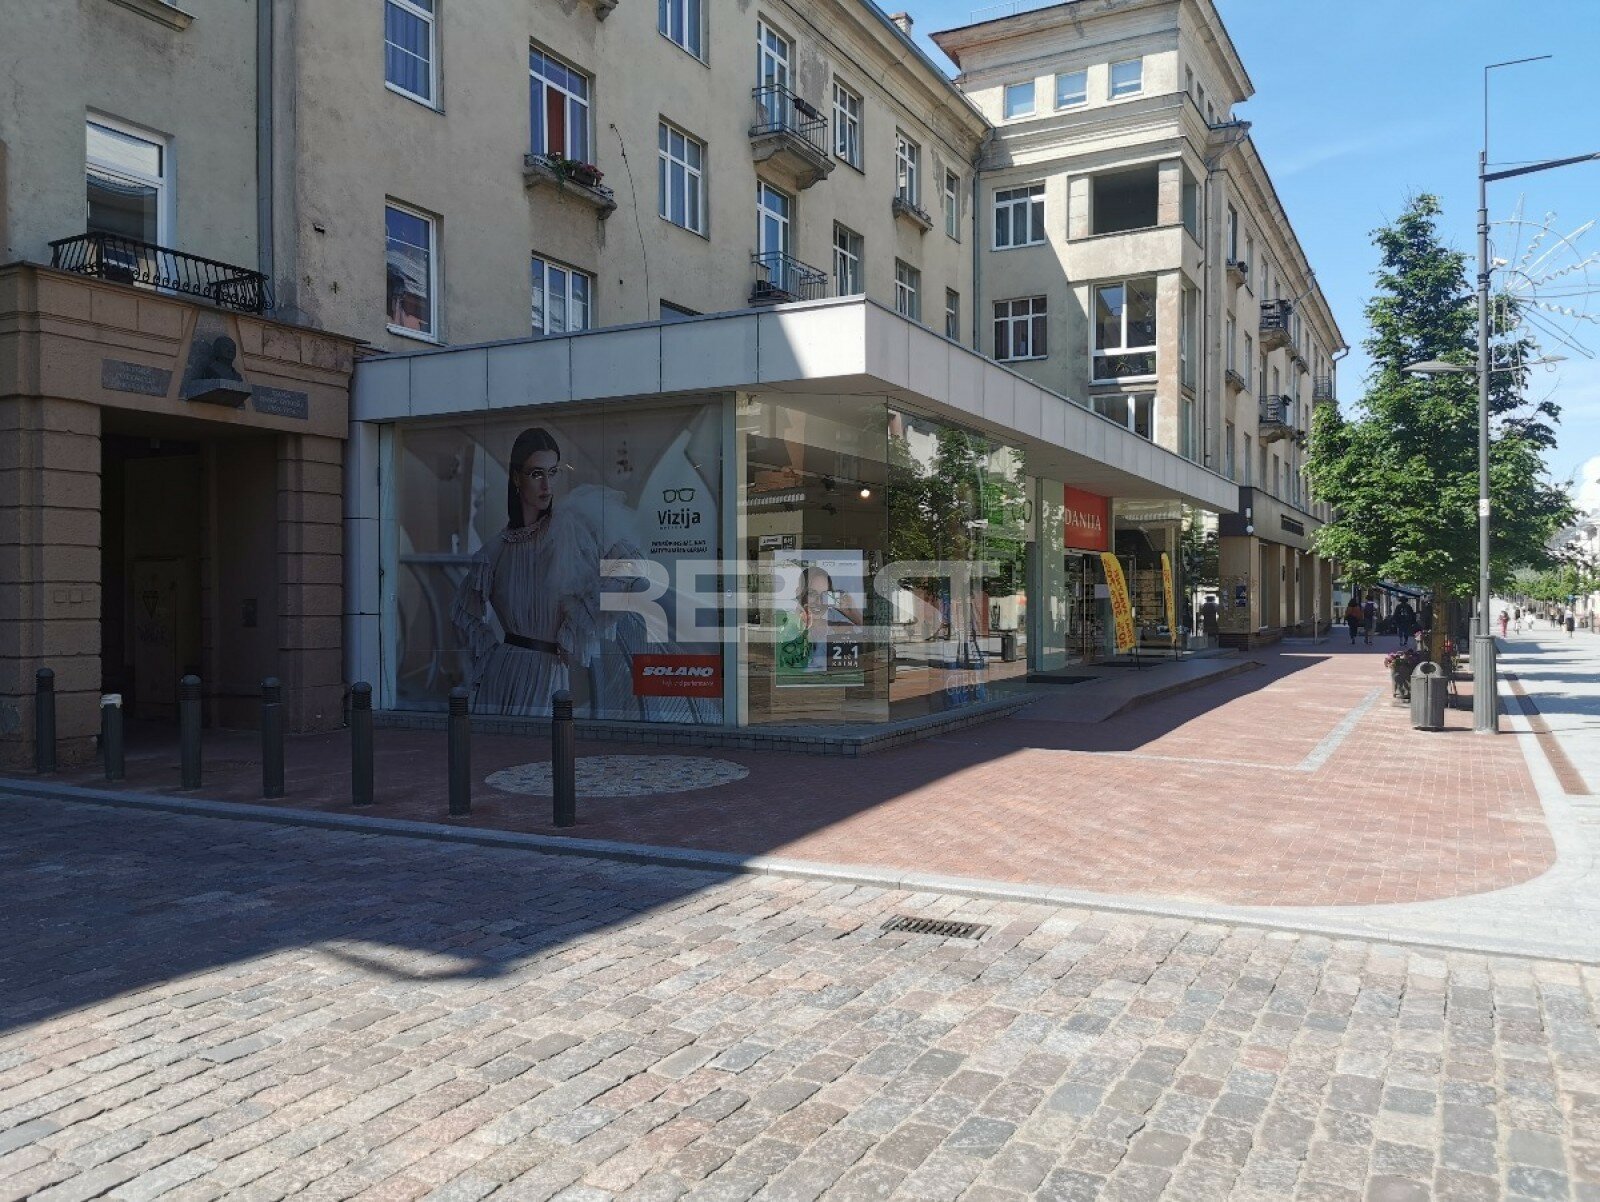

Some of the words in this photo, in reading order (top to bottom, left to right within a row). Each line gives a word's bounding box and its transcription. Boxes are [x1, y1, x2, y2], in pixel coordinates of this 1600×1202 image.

[657, 508, 701, 529] Vizija
[832, 646, 842, 660] 2
[851, 645, 859, 659] 1
[642, 666, 714, 677] SOLANO
